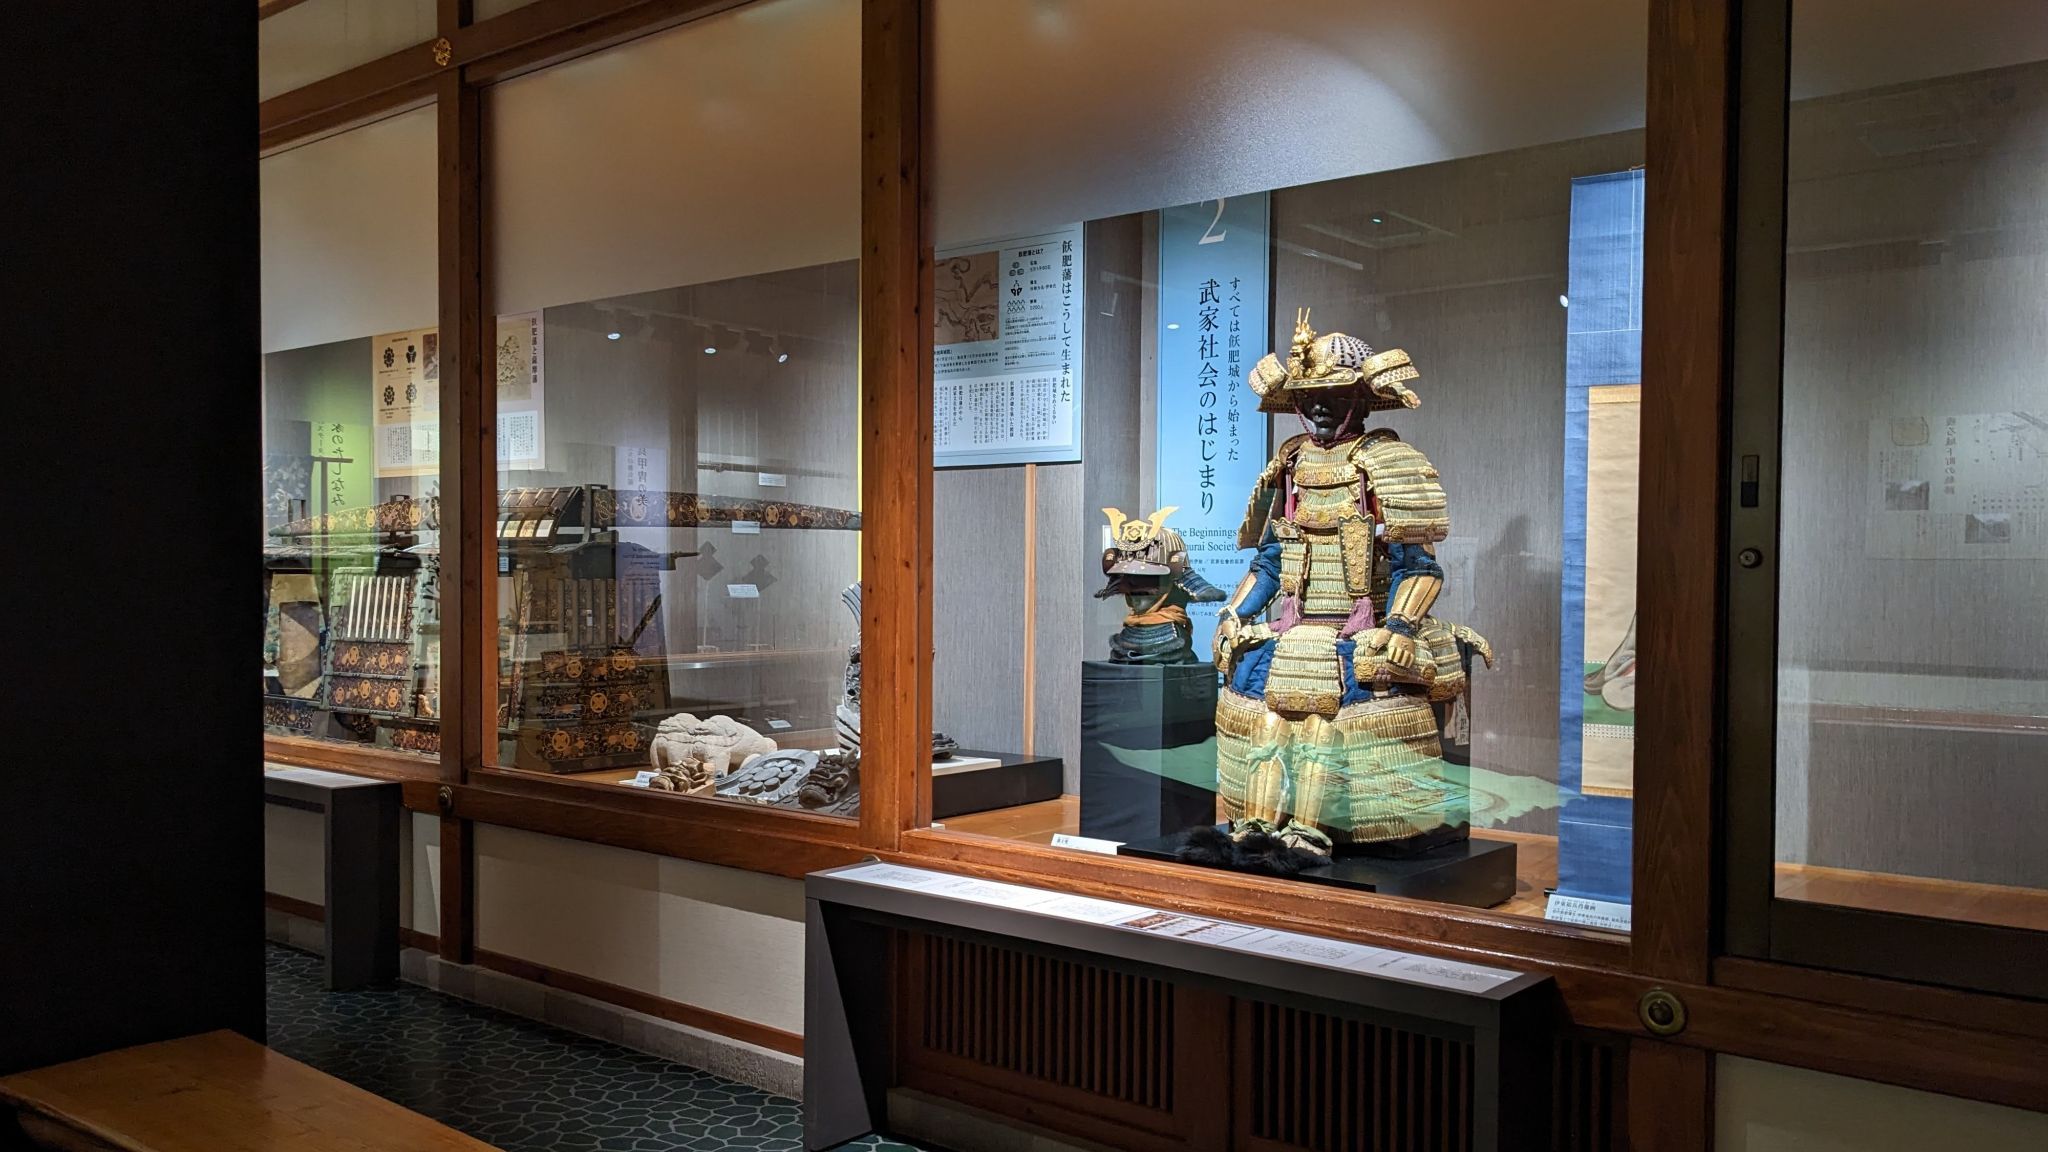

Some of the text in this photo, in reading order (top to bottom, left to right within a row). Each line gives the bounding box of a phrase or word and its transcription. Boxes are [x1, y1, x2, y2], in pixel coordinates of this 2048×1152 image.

[1199, 198, 1226, 244] 2
[1060, 240, 1073, 402] 飫肥藩はこうして生まれた
[1198, 278, 1220, 515] 武家社会のはじまり
[1228, 276, 1241, 461] すべては飫肥城から始まった
[1172, 526, 1237, 539] The Beginnings
